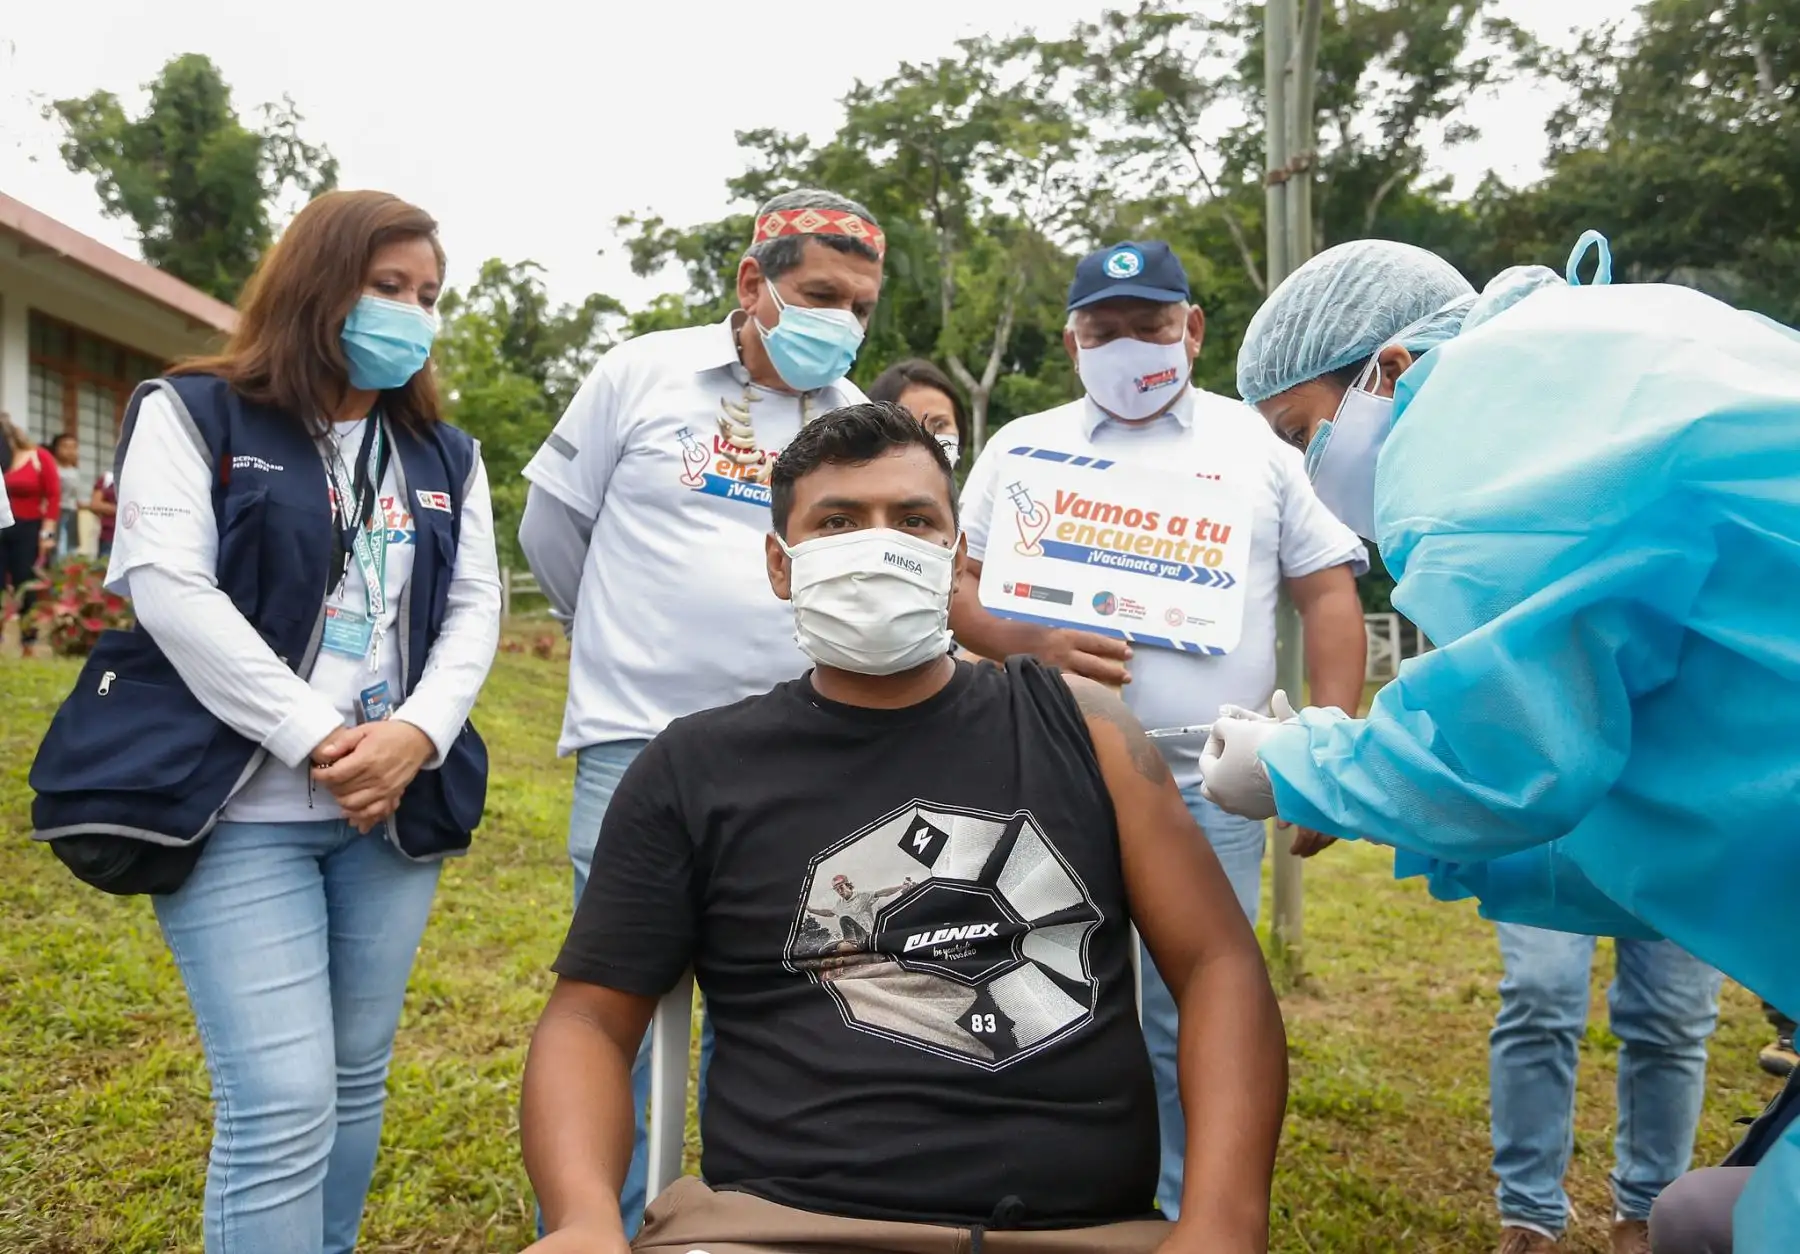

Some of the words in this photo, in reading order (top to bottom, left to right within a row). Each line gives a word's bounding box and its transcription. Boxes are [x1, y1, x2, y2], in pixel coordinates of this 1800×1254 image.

[1055, 489, 1160, 531] Vamos
[1167, 516, 1189, 537] a
[1195, 517, 1232, 544] tu
[1056, 521, 1224, 568] encuentro
[884, 551, 922, 574] MINSA
[1087, 550, 1157, 573] ¡Vacúnate
[1158, 564, 1182, 578] ya!
[971, 1013, 996, 1033] 83
